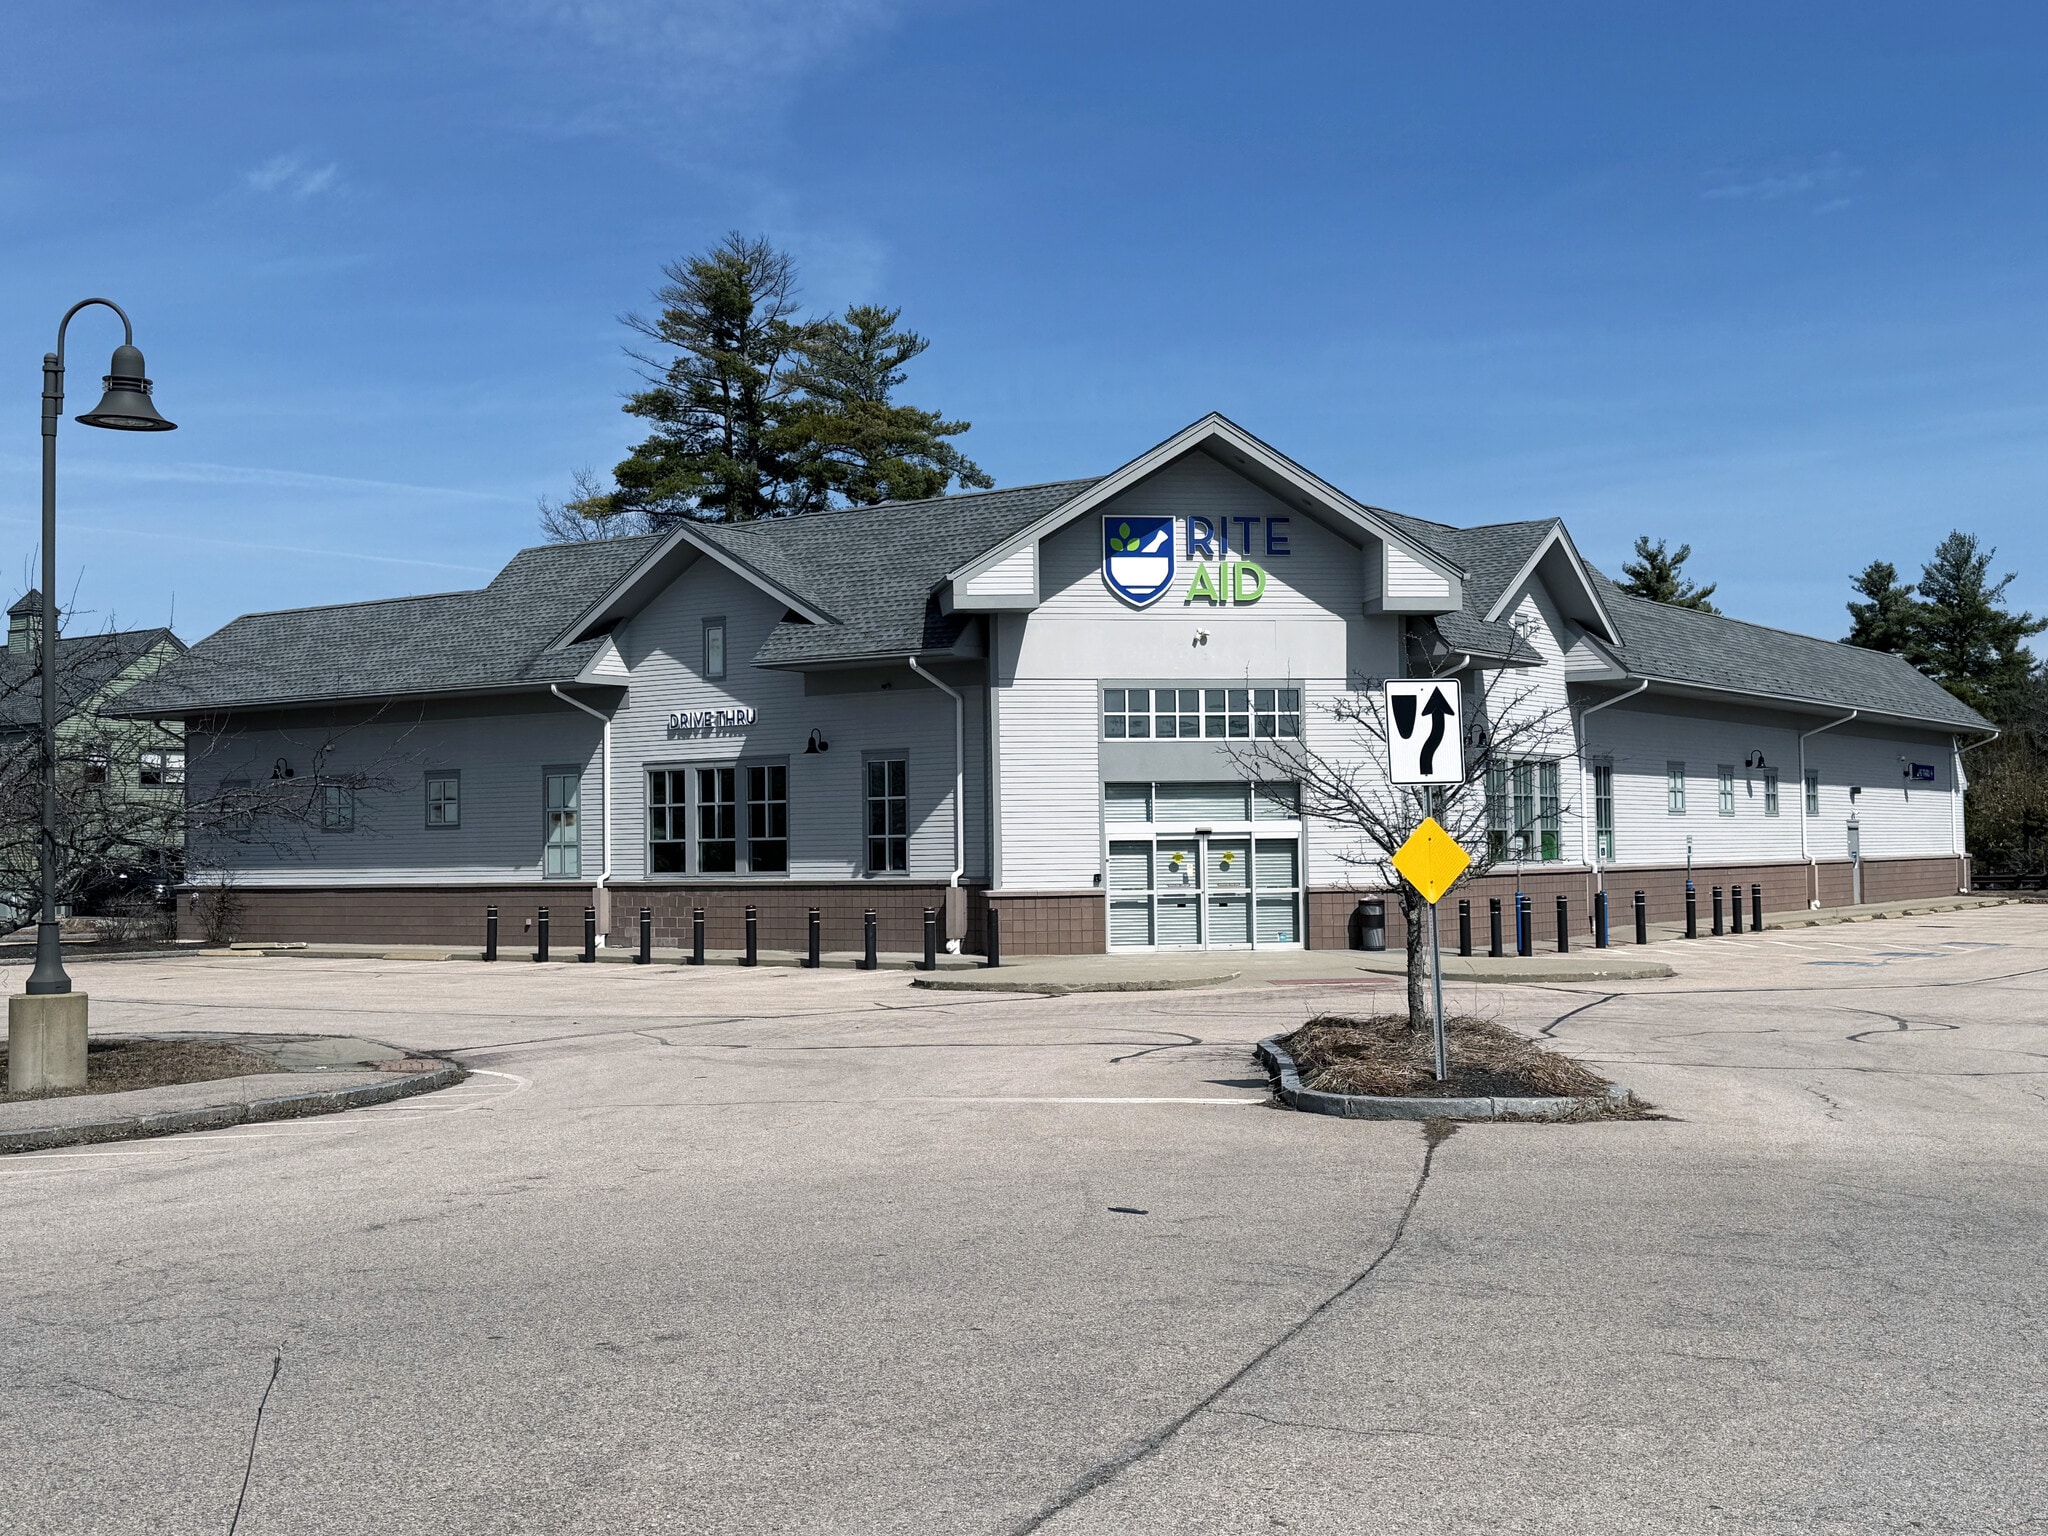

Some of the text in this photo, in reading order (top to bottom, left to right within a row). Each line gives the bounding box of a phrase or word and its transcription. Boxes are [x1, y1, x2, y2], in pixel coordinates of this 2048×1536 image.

[1187, 516, 1291, 555] RITE
[1186, 562, 1266, 600] AID
[669, 709, 757, 729] DRIVE THRU
